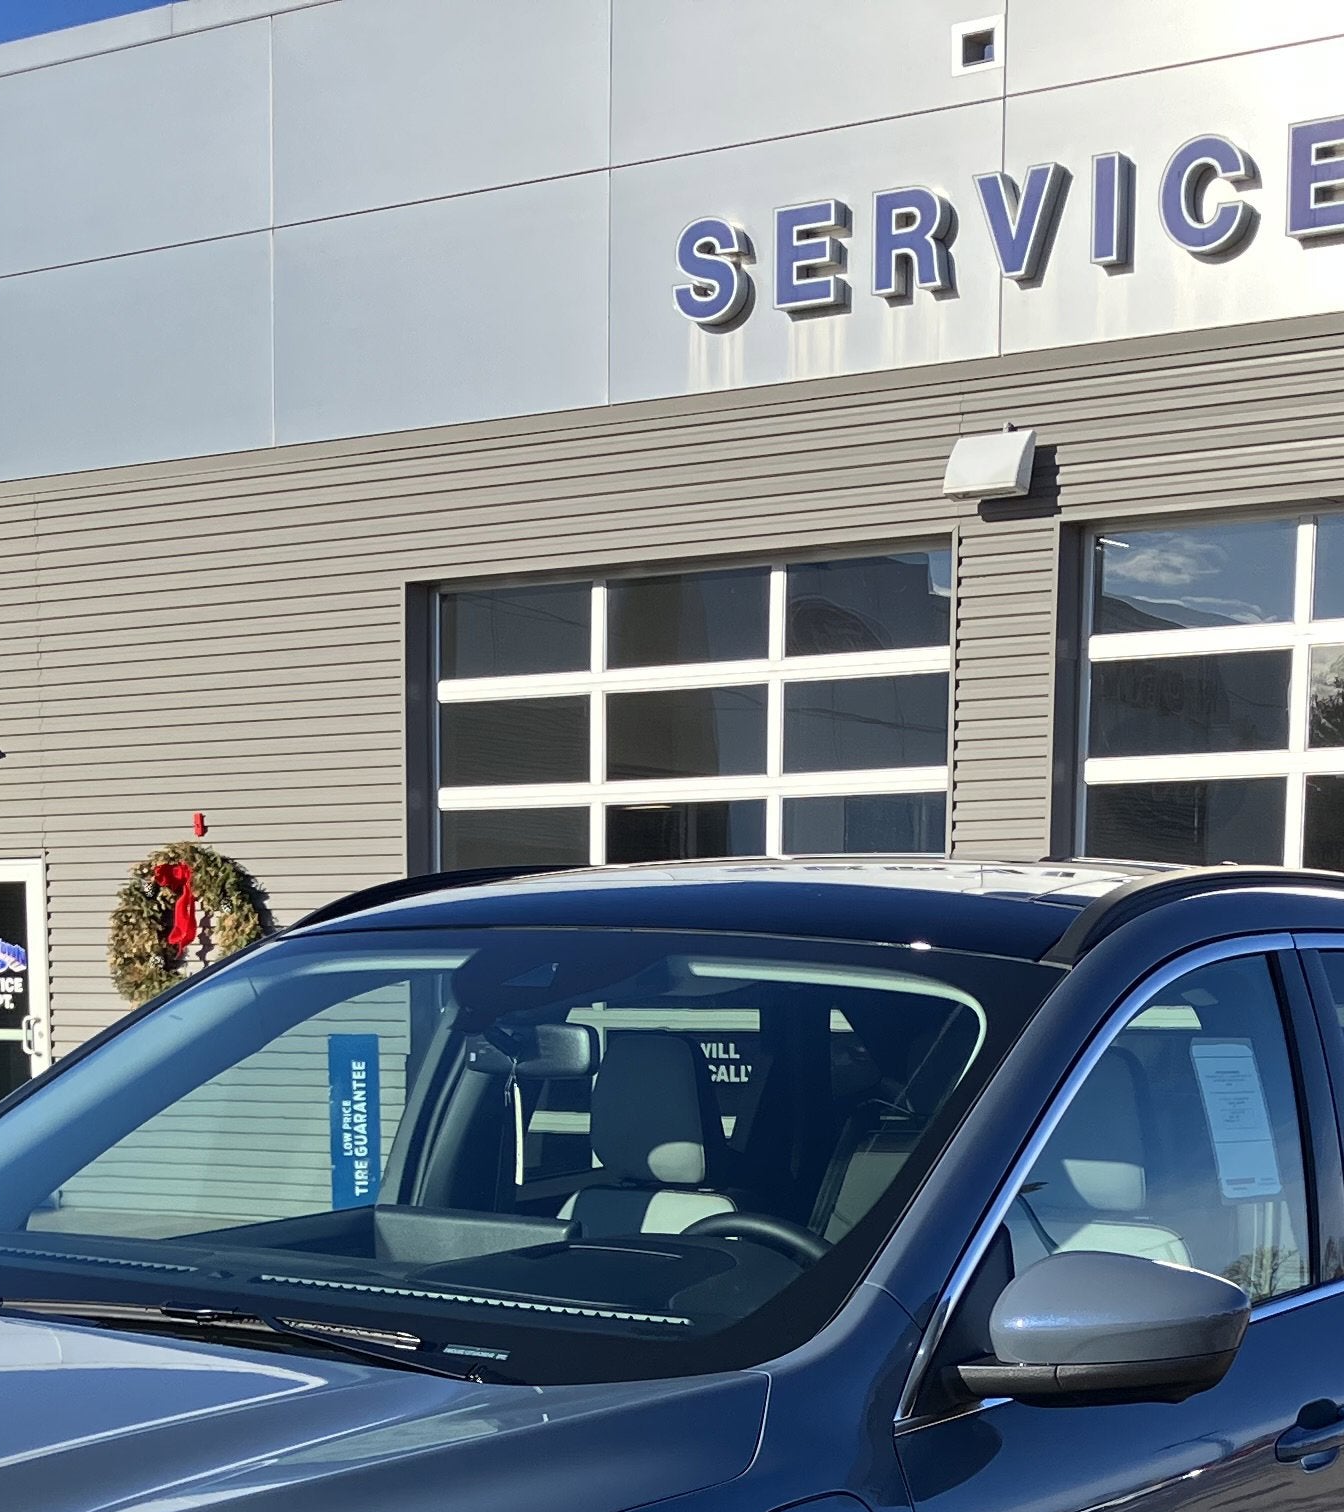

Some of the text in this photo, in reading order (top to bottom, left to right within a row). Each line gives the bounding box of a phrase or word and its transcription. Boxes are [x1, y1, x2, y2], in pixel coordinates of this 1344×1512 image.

[341, 1099, 354, 1157] LOW PRICE
[351, 1060, 369, 1197] TIRE GUARANTEE
